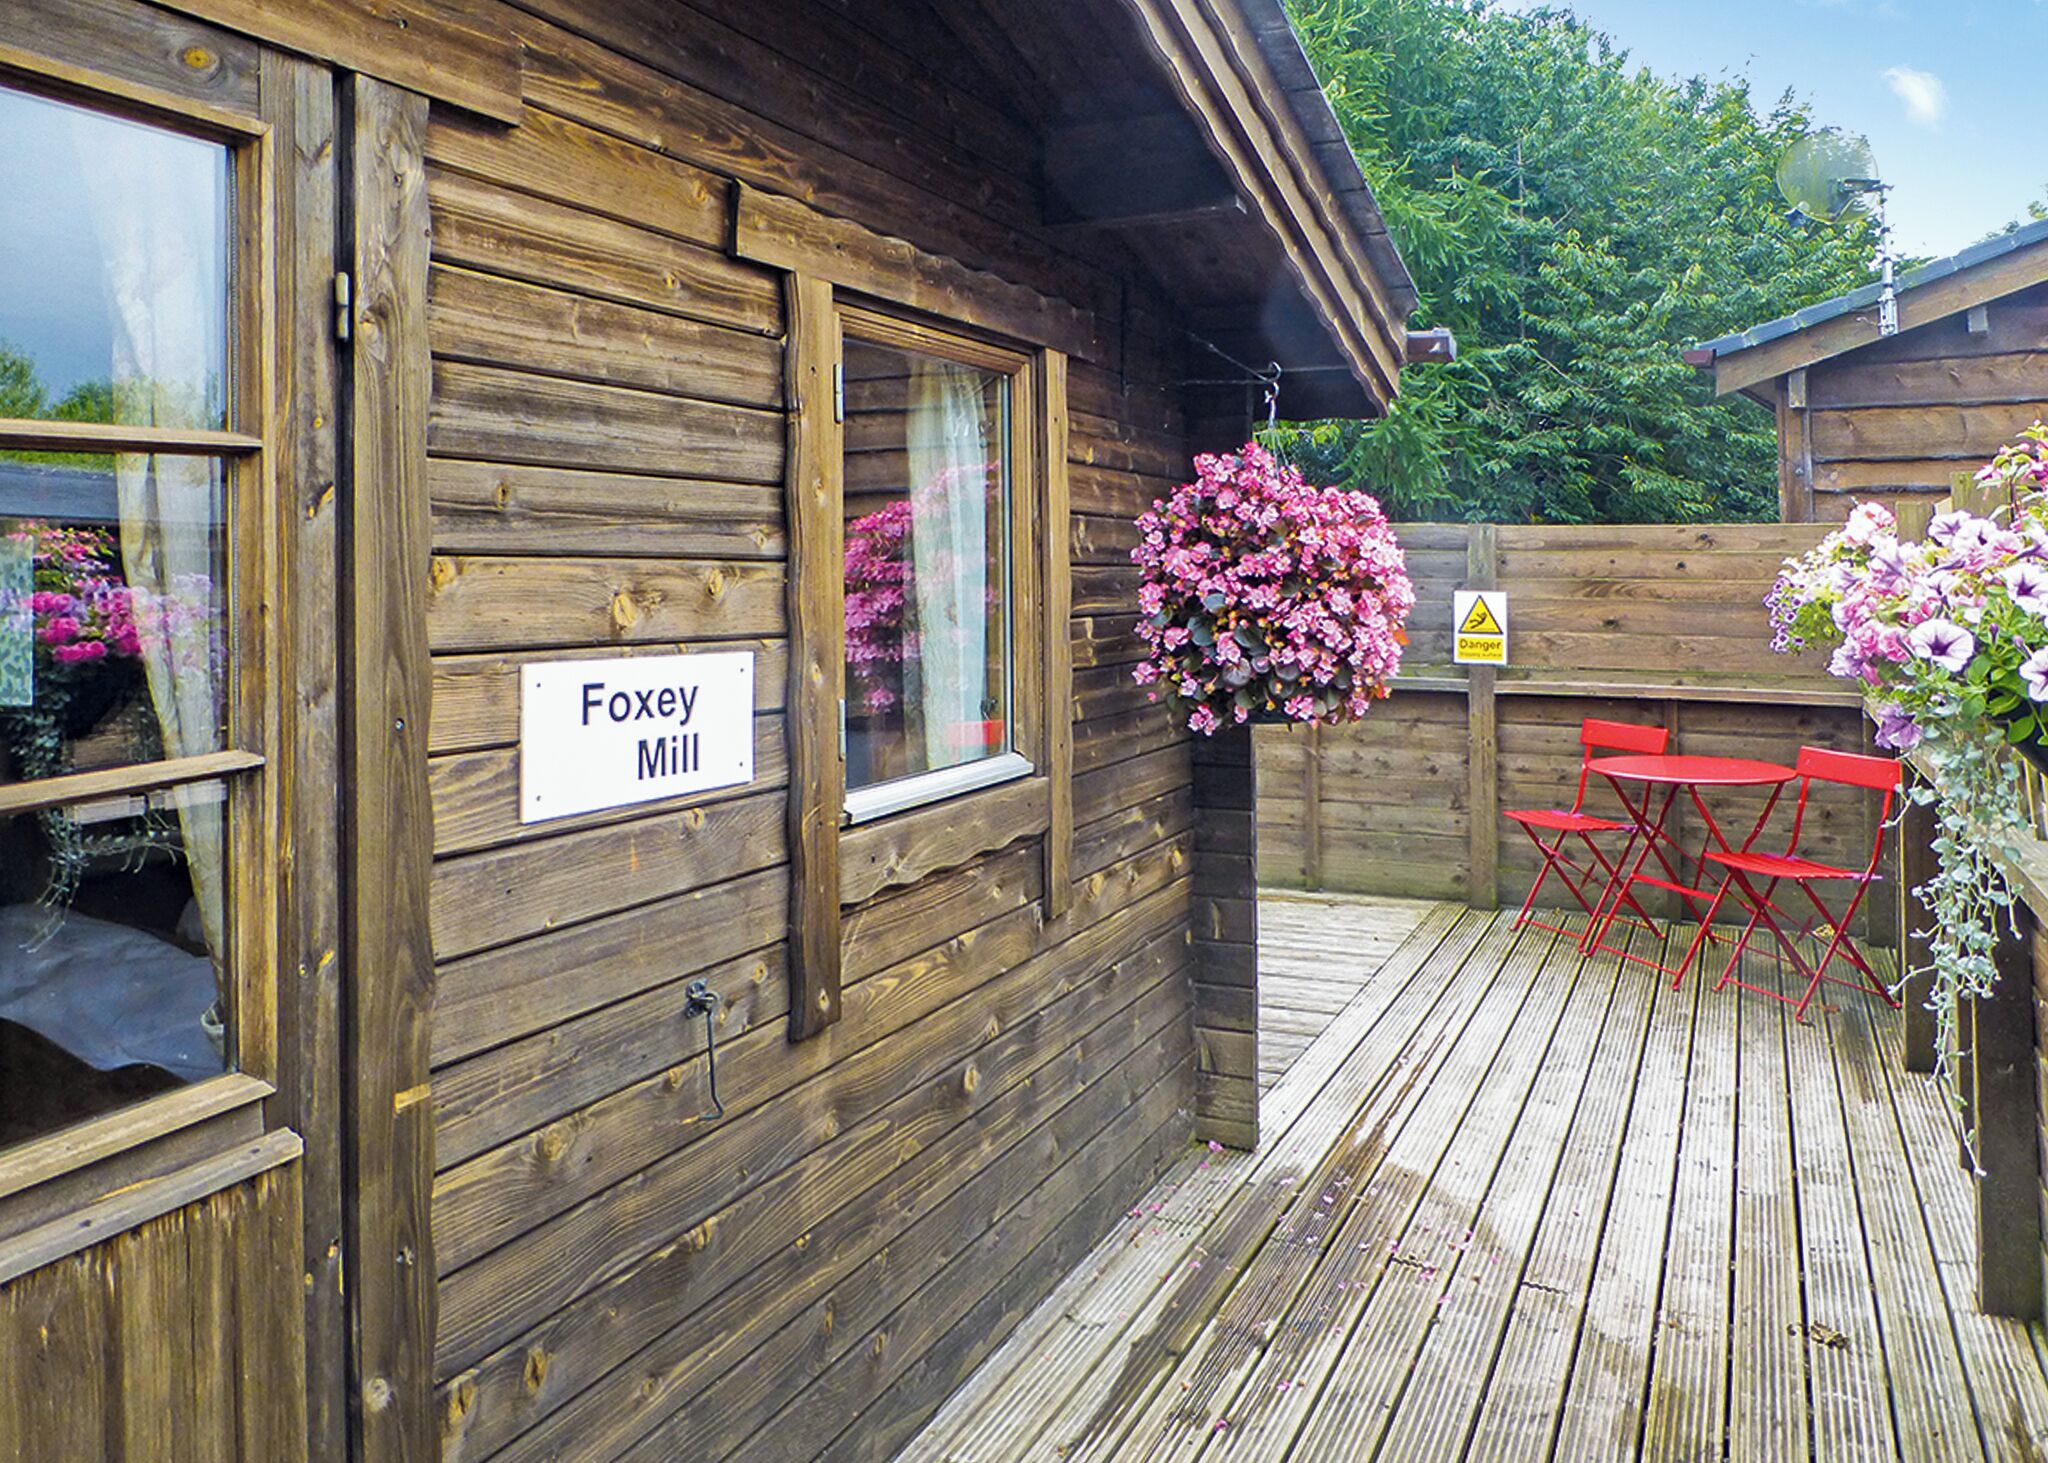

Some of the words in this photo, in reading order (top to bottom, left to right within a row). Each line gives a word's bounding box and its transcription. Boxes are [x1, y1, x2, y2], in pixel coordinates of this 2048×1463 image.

[1460, 639, 1501, 651] Danger
[582, 682, 698, 726] Foxey
[637, 733, 698, 780] Mill
